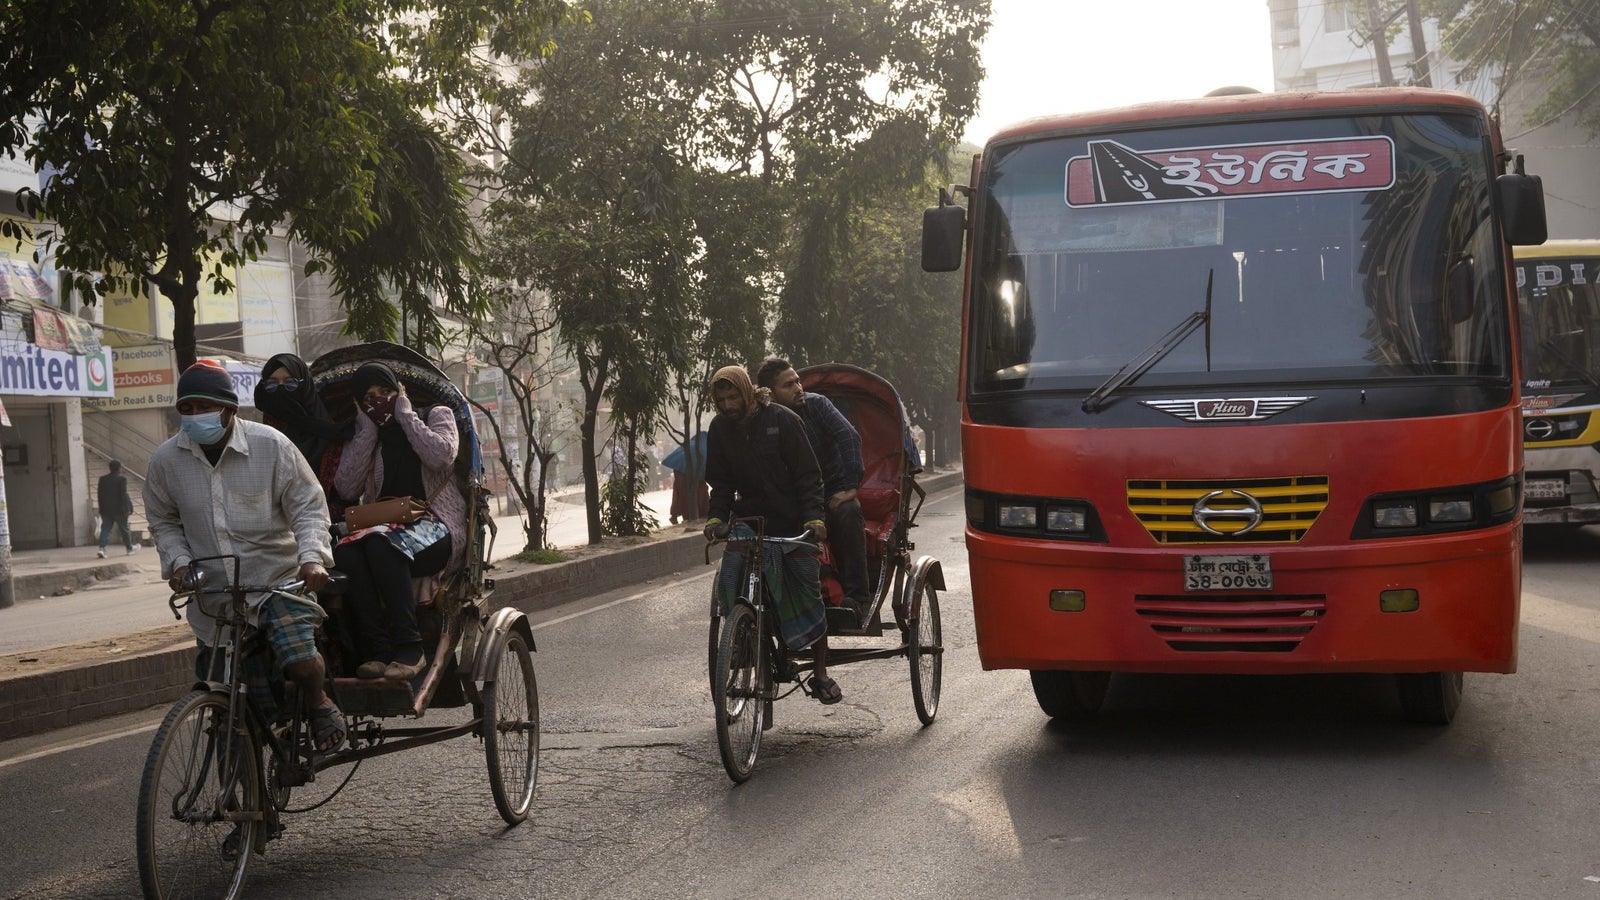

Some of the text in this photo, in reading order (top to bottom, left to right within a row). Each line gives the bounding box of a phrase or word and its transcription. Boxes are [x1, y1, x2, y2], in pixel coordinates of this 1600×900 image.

[1161, 150, 1371, 193] ইউনিক
[1516, 263, 1600, 288] DI
[121, 349, 164, 360] facebook
[0, 346, 80, 391] mited
[109, 397, 121, 406] for
[123, 395, 146, 405] Read
[147, 395, 154, 403] &
[157, 394, 174, 404] Buy
[1206, 401, 1246, 416] Hino
[1189, 561, 1215, 573] ঢাকা
[1189, 575, 1269, 588] ১৪-০০৬৬
